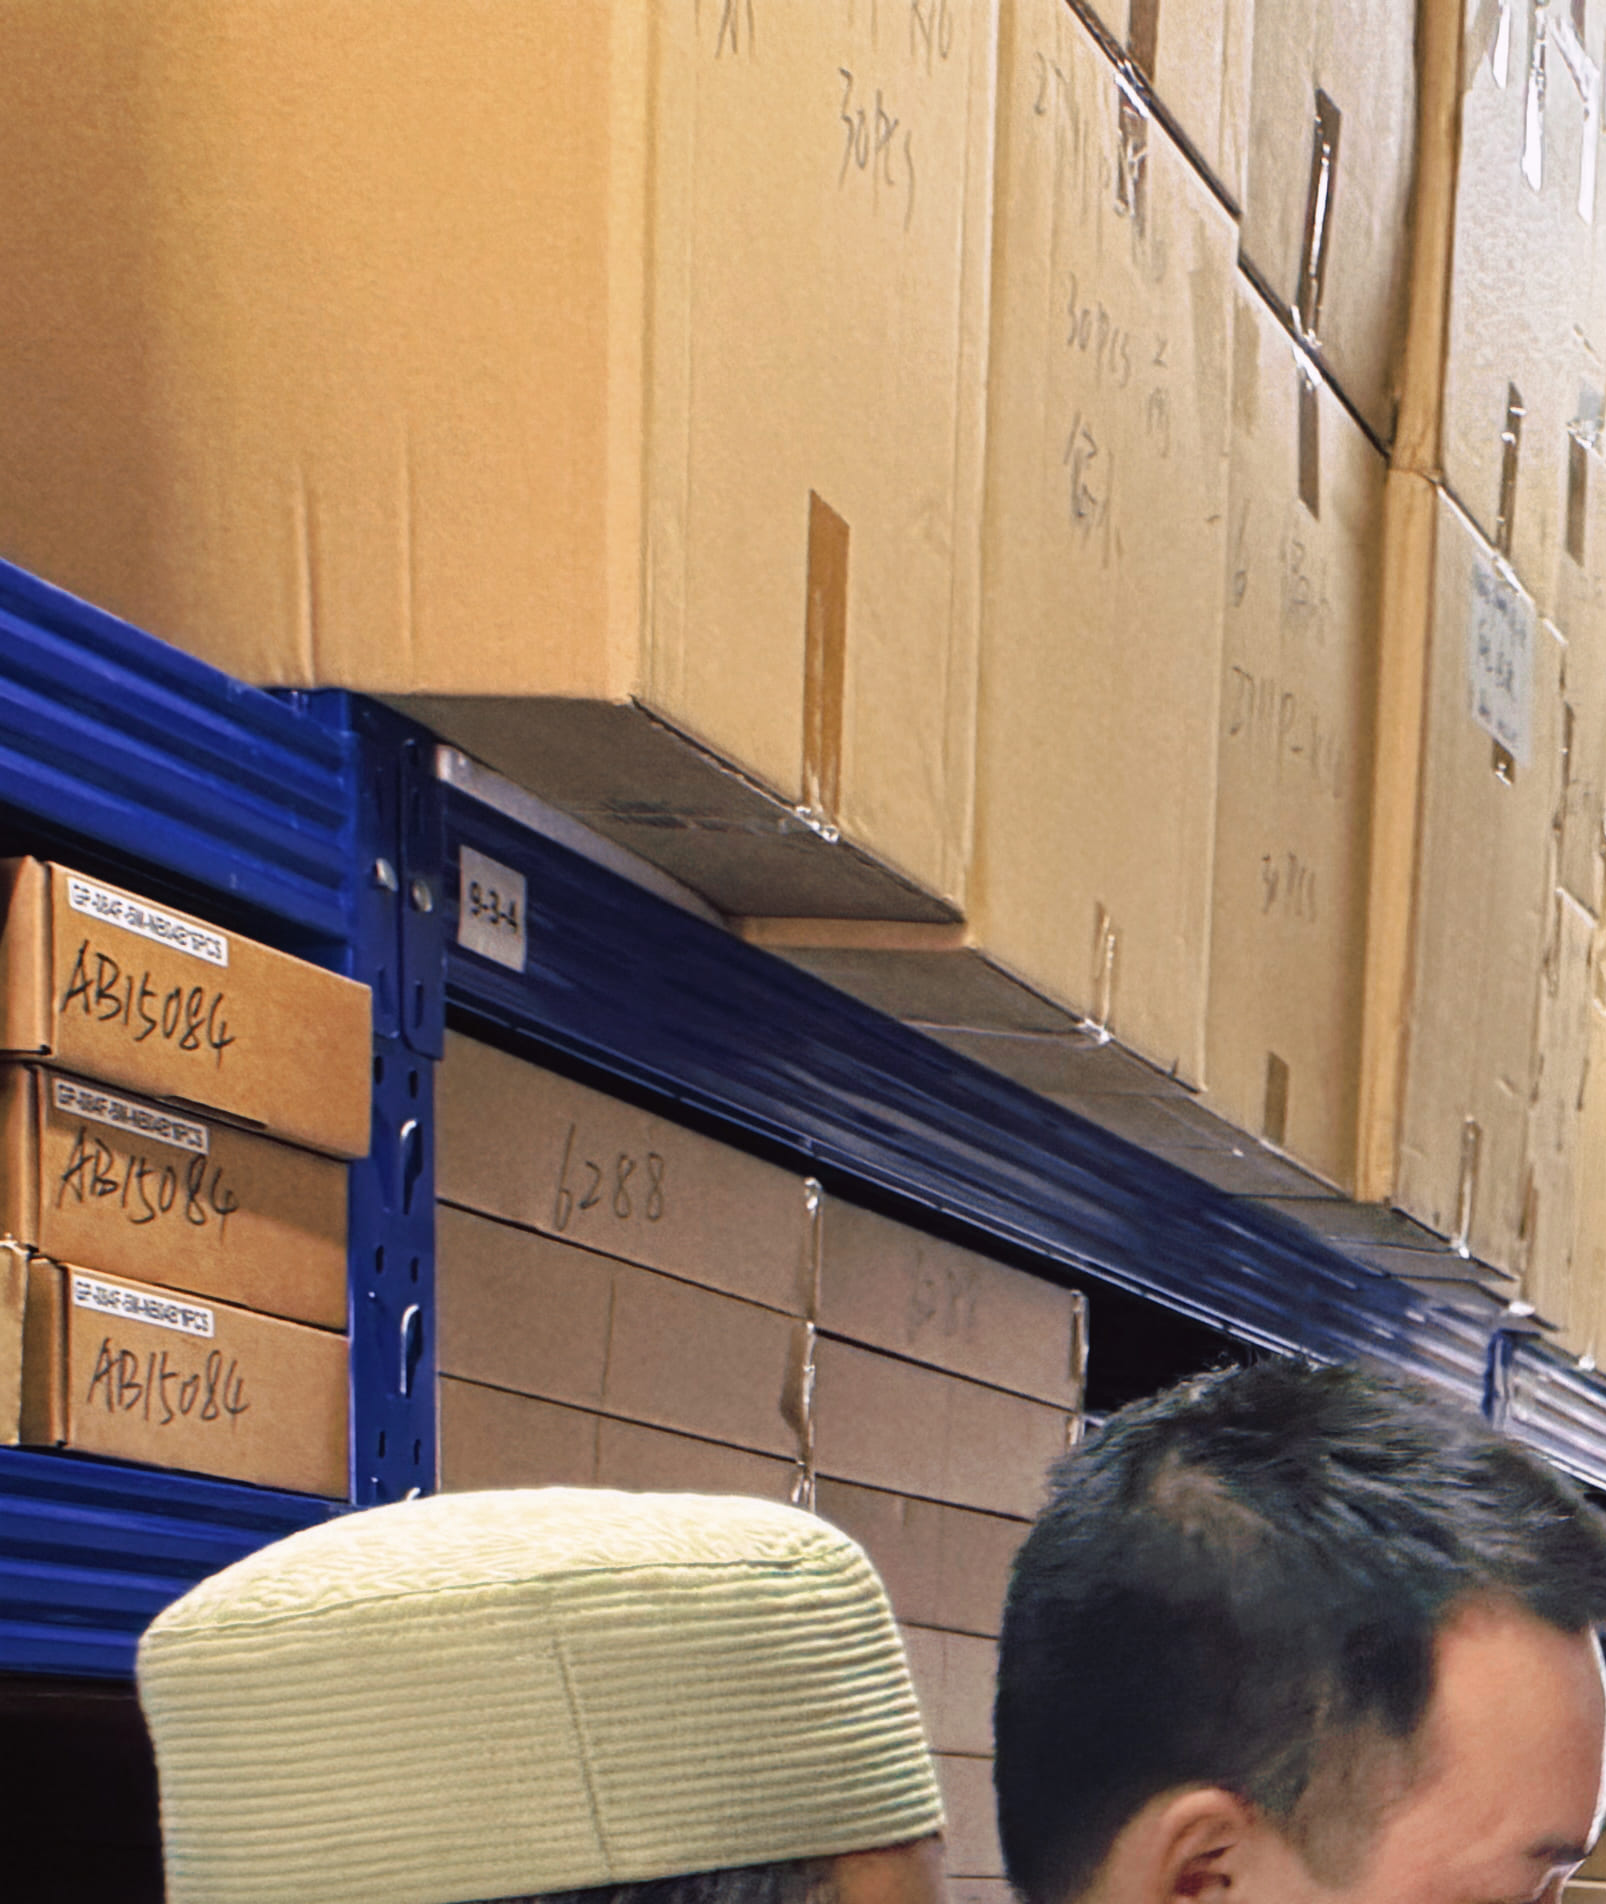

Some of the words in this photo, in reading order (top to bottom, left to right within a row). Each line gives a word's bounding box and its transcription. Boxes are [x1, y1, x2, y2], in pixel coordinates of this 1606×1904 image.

[470, 880, 519, 935] 9-3-4
[58, 939, 237, 1069] AB15084
[55, 1126, 240, 1241] AB15084
[552, 1122, 666, 1234] 6288
[86, 1336, 251, 1425] AB15084
